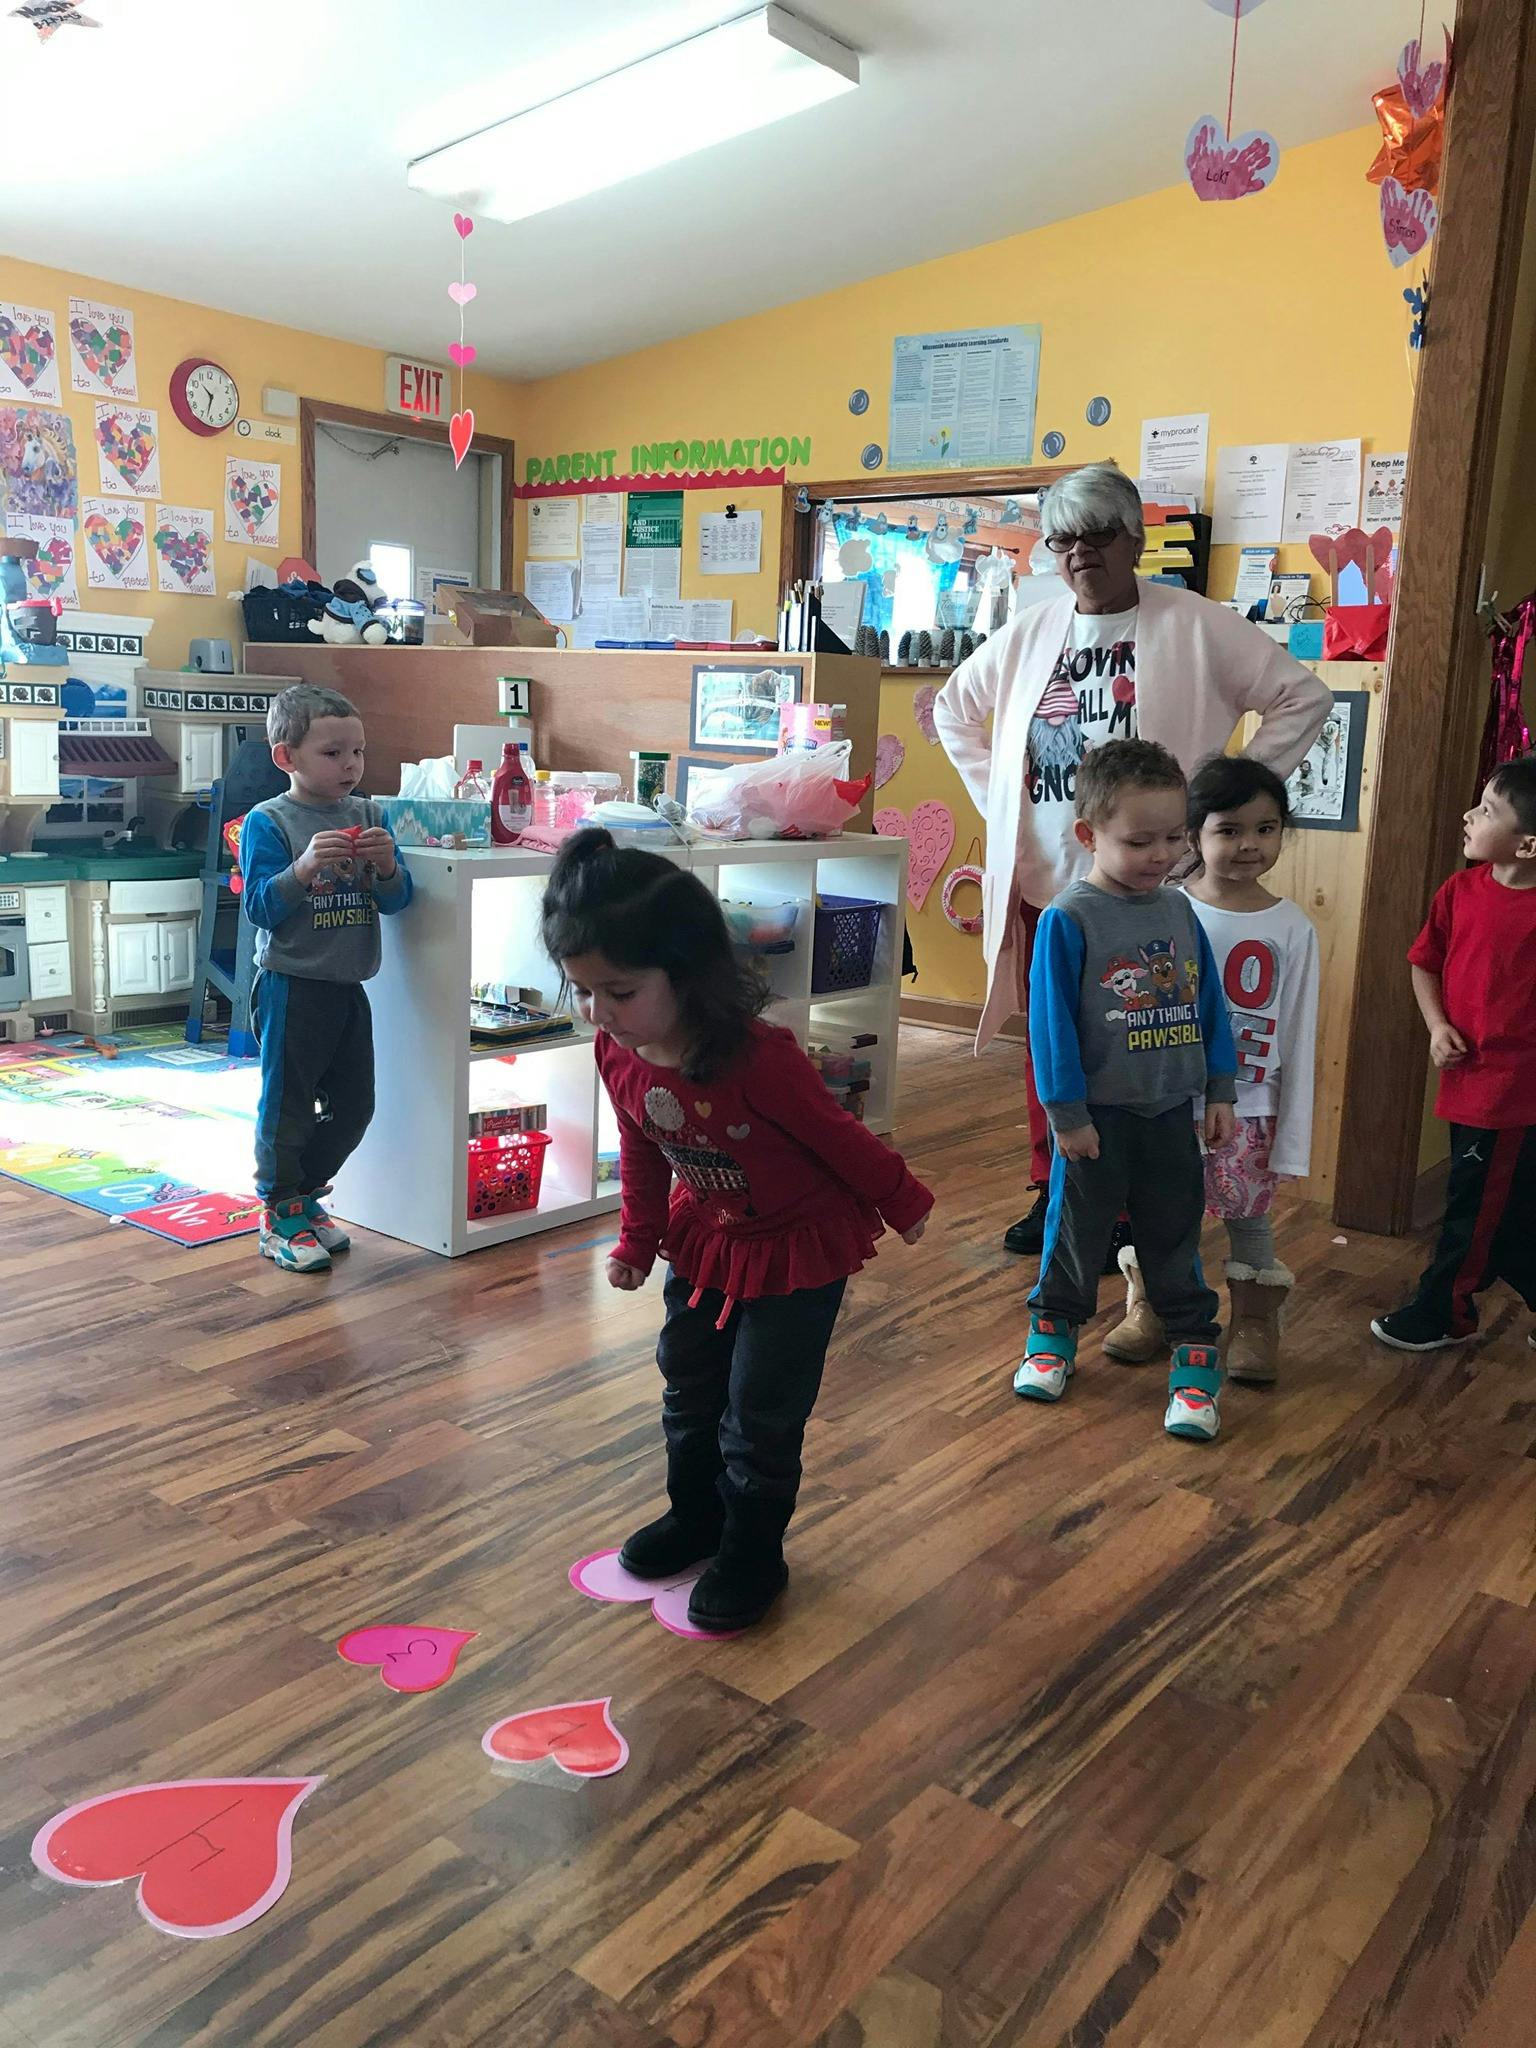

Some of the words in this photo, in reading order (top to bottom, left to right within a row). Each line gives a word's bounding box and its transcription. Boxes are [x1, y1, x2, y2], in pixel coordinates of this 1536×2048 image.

[1390, 218, 1416, 239] Simon
[399, 363, 444, 416] EXIT
[1160, 427, 1198, 437] myprocare
[526, 449, 617, 484] PARENT
[631, 436, 812, 473] INFORMATION
[1371, 460, 1391, 468] Keep
[1392, 459, 1405, 467] Me
[632, 525, 660, 533] JUSTICE
[640, 532, 651, 540] ALL
[510, 683, 523, 710] 1
[1077, 688, 1109, 724] ALL
[1108, 700, 1138, 738] M
[314, 909, 372, 929] PAWSBLE
[1127, 1005, 1191, 1028] ANYTHING
[1129, 1023, 1202, 1051] PAWSIBL
